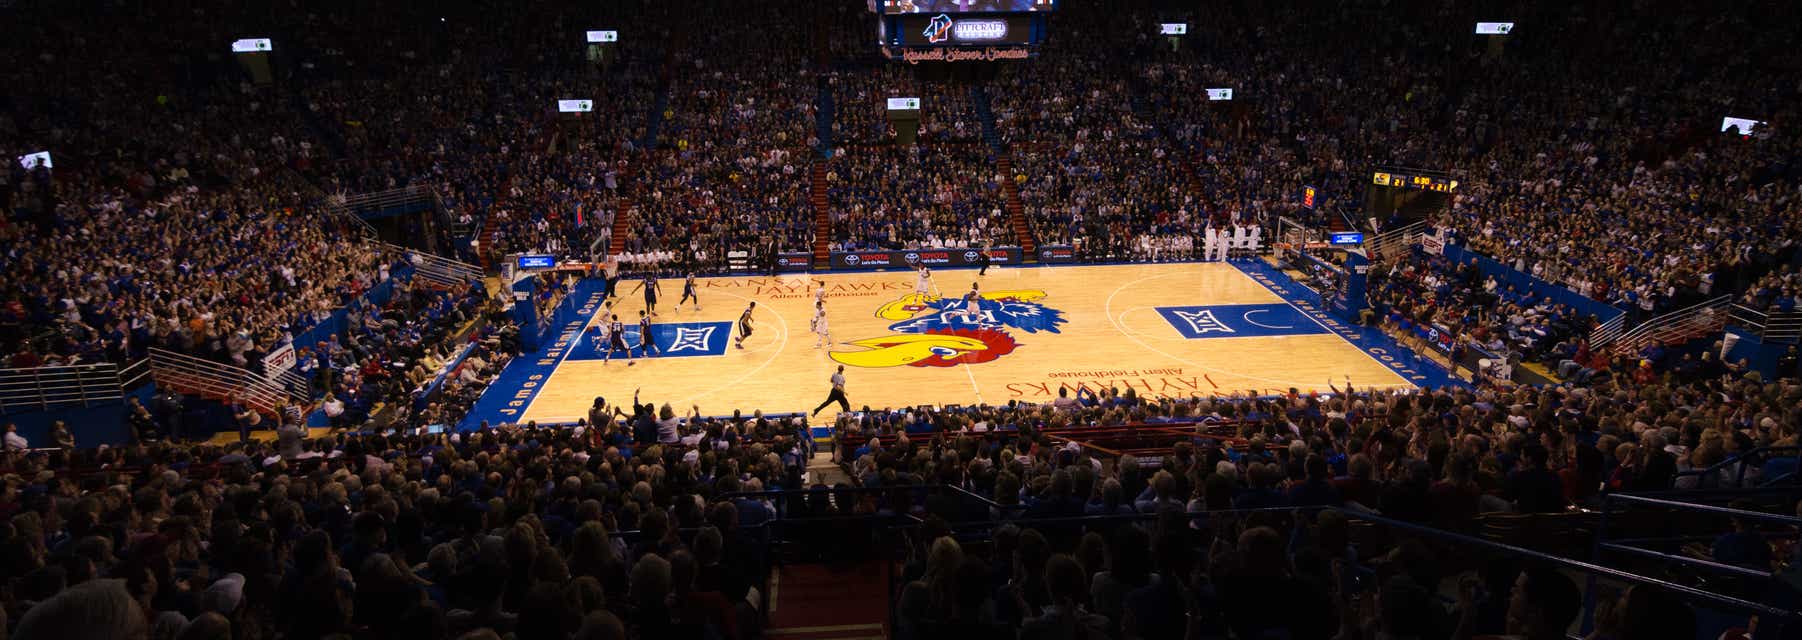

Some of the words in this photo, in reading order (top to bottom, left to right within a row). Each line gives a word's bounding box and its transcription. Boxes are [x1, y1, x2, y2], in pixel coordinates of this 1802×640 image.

[902, 47, 944, 64] Russell
[946, 47, 985, 62] Stover
[986, 46, 1028, 61] Candies
[706, 277, 824, 287] KANSAS
[1249, 272, 1289, 295] James
[1294, 300, 1361, 340] Naismith
[1369, 347, 1427, 380] Court
[501, 373, 543, 415] James
[537, 321, 584, 365] Naismith
[577, 292, 605, 315] Court
[1048, 369, 1140, 378] Fieldhouse
[1144, 367, 1183, 377] Allen
